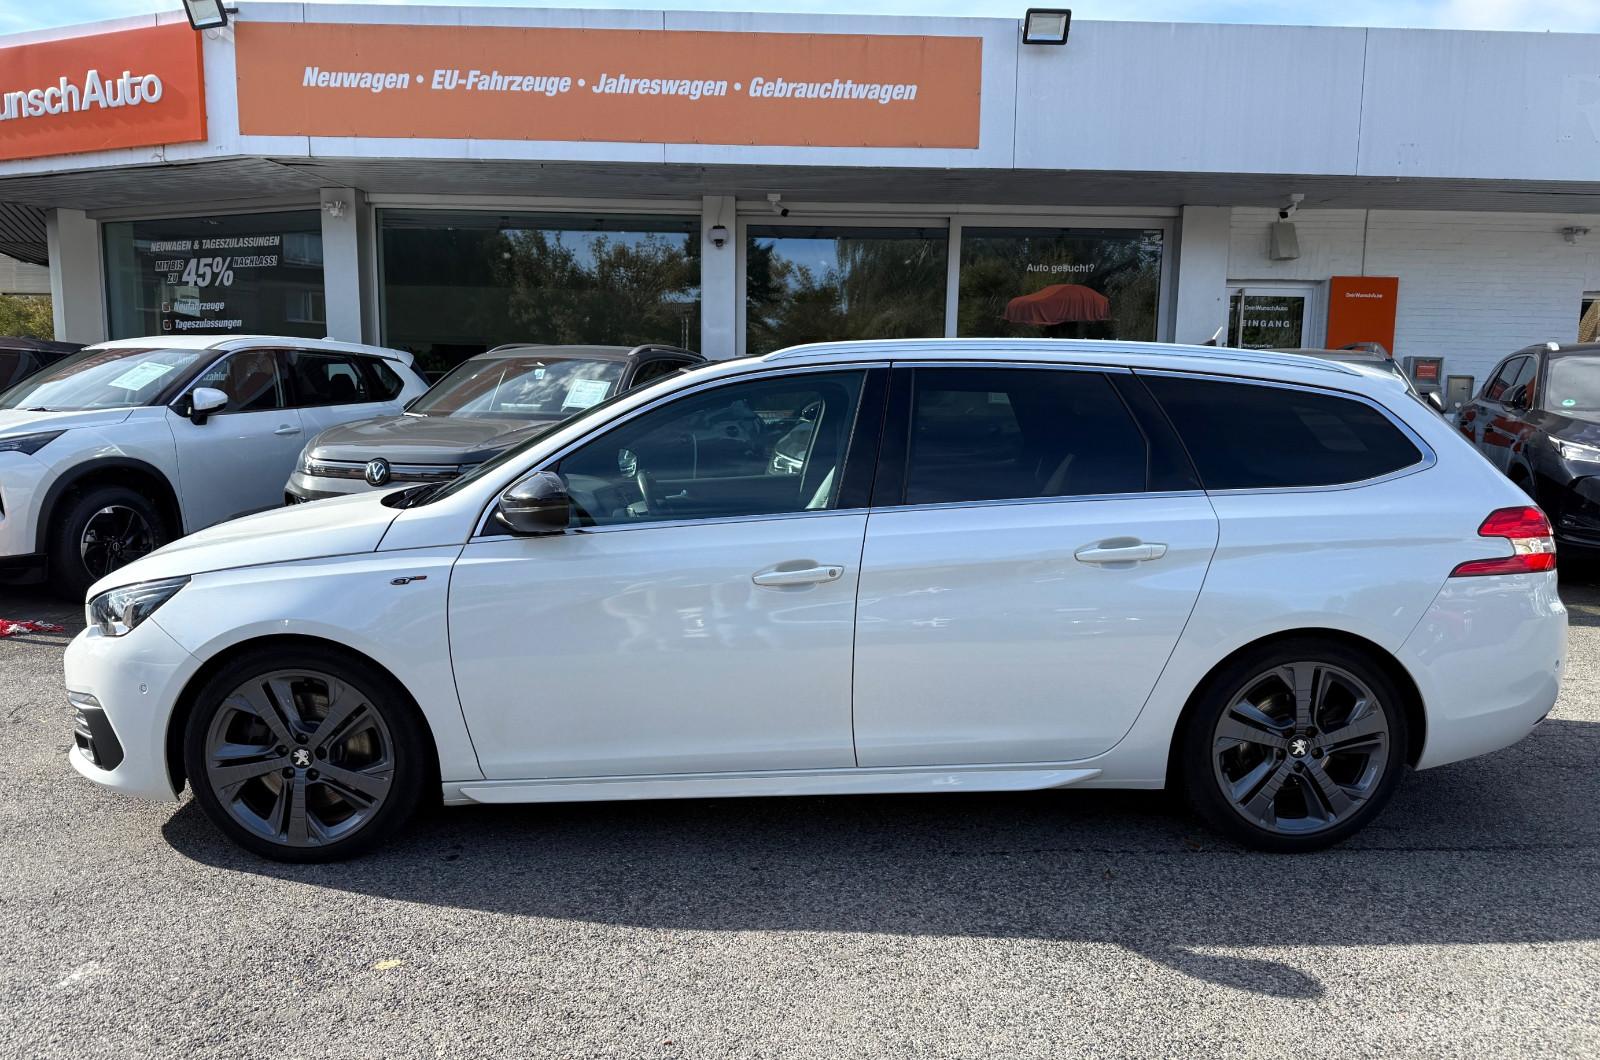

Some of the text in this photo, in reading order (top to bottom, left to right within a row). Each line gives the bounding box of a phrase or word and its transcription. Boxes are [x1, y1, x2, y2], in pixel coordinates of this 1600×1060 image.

[302, 66, 918, 104] Neuwagen EU-Fahrzeuge Jahreswagen Gebrauchtwagen
[150, 236, 280, 252] NEUWAGEN & TAGESZULASSUNGEN
[154, 259, 184, 272] MIT BIS
[233, 255, 278, 267] NACHLASS!
[181, 256, 234, 288] 45%
[1026, 263, 1095, 274] Auto gesucht?
[167, 273, 179, 284] ZU
[173, 301, 224, 312] Neufahrzeuge
[175, 318, 242, 330] Tageszulassungen
